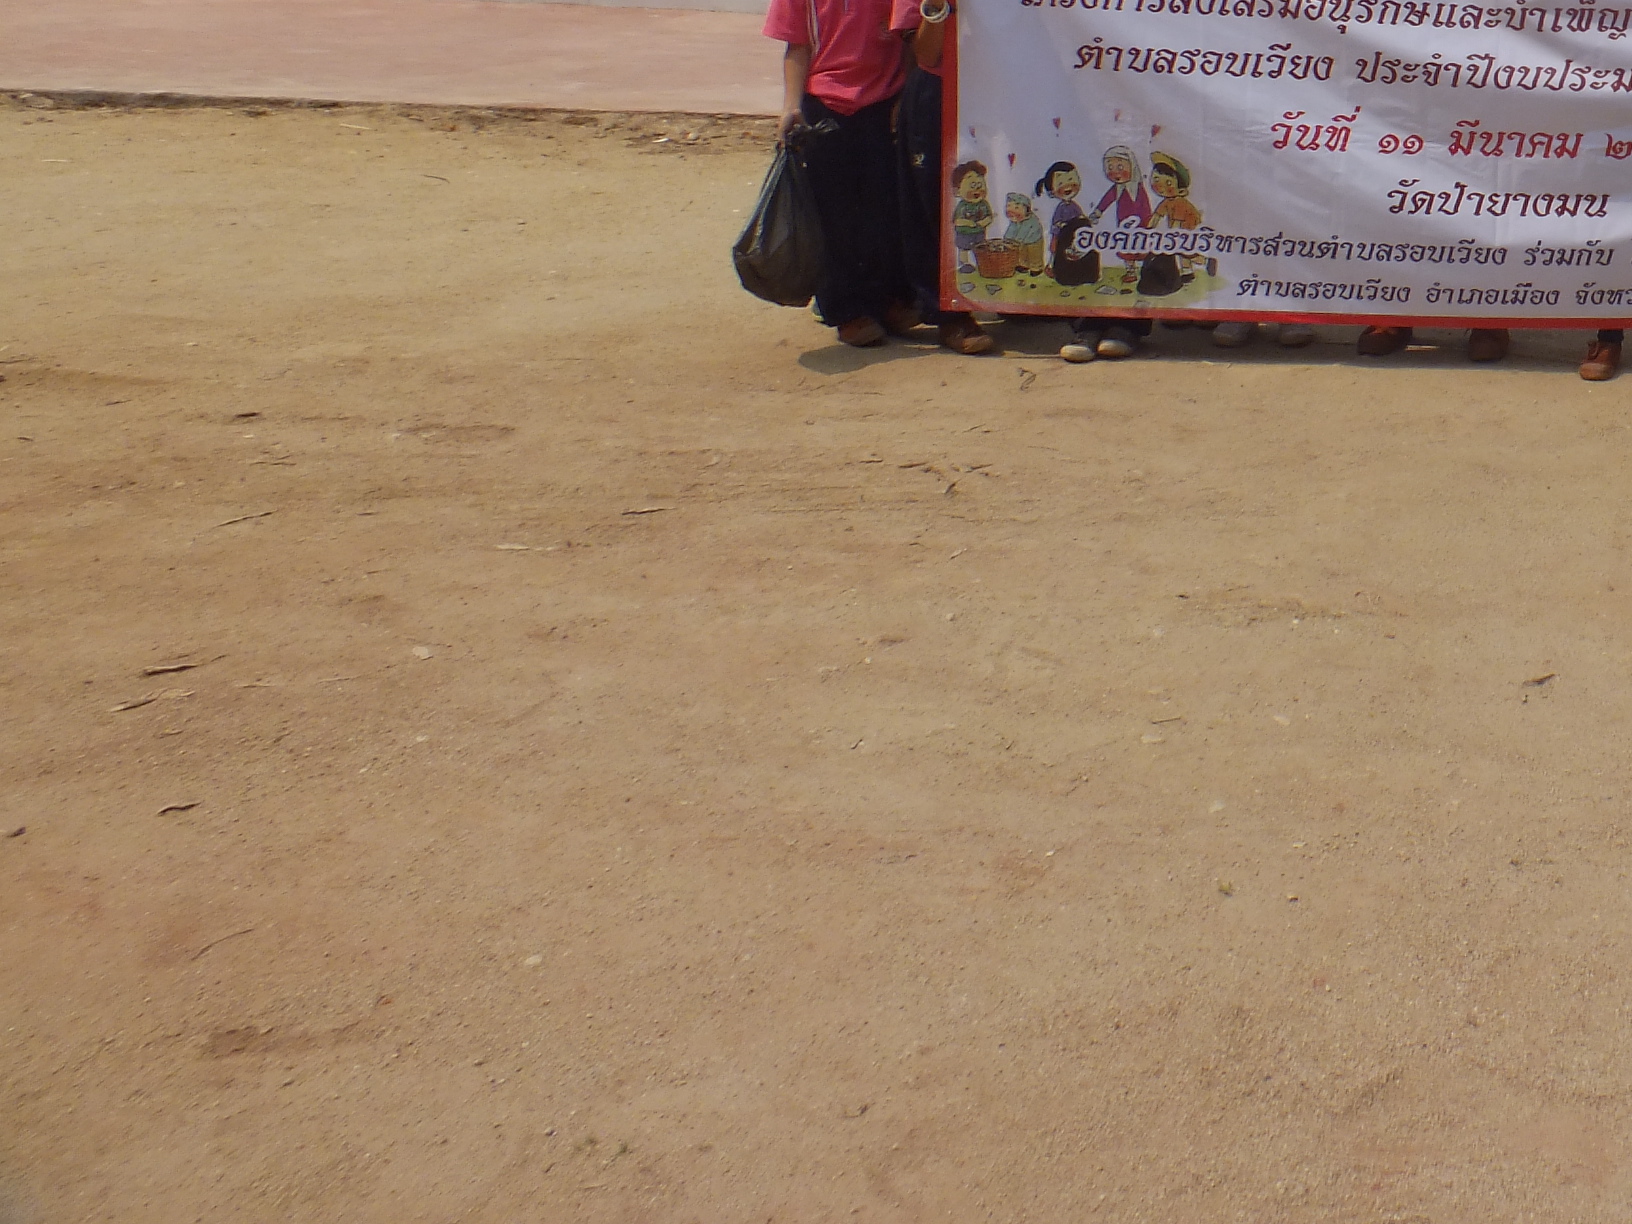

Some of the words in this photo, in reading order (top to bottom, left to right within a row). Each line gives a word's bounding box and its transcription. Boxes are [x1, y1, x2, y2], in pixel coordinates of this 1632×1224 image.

[1073, 36, 1335, 81] ตำบลรอบเวียง
[1270, 105, 1362, 153] วันที่
[1377, 133, 1424, 155] ๑๑
[1448, 119, 1585, 159] มีนาคม
[1386, 178, 1611, 218] วัดป่ายางมน
[1077, 218, 1508, 266] องค์การบริหารส่วนตำบลรอบเวียง
[1523, 239, 1615, 267] ร่วมกับ
[1235, 273, 1411, 304] ตำบลรอบเวียง
[1426, 282, 1560, 306] อำเภอเมือง
